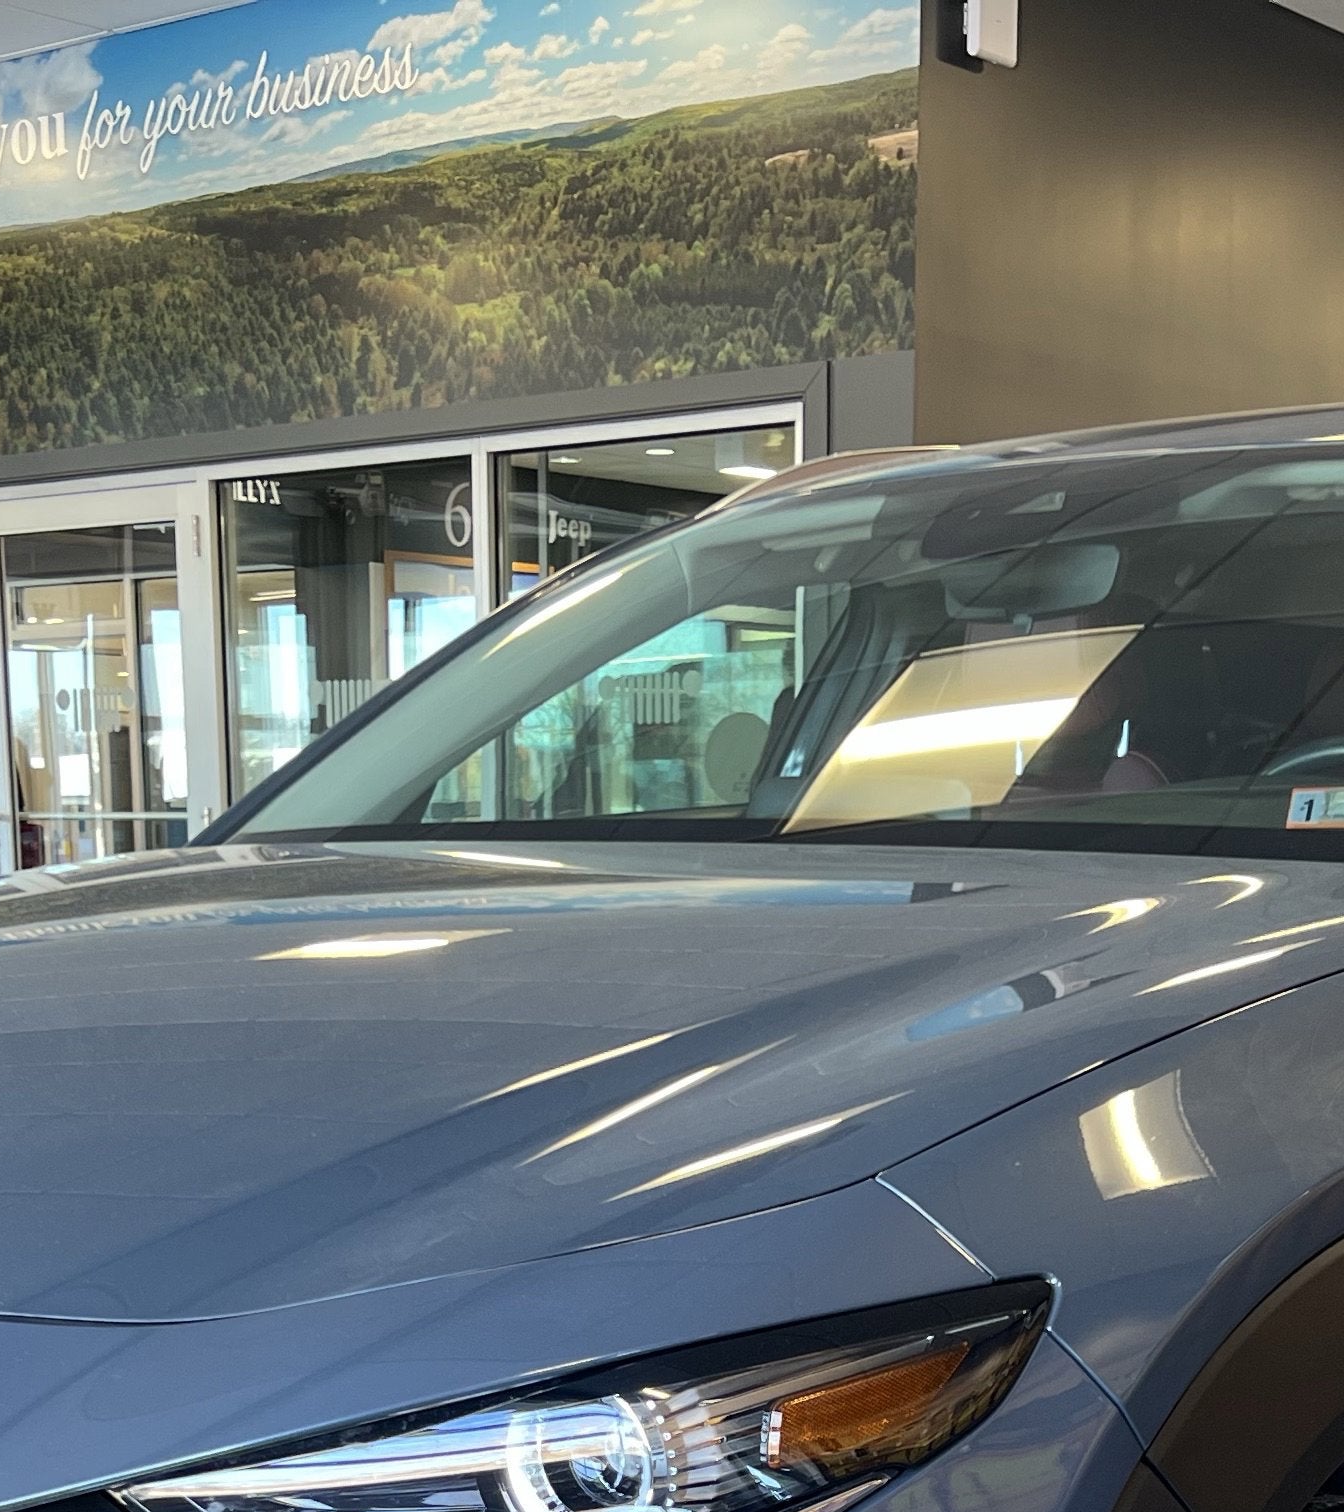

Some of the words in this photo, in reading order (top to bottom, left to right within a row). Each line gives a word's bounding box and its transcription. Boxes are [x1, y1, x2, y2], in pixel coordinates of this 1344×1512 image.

[76, 89, 135, 181] for
[140, 82, 236, 173] your
[246, 42, 420, 119] business
[548, 510, 592, 547] Jeep
[1303, 799, 1314, 822] 1
